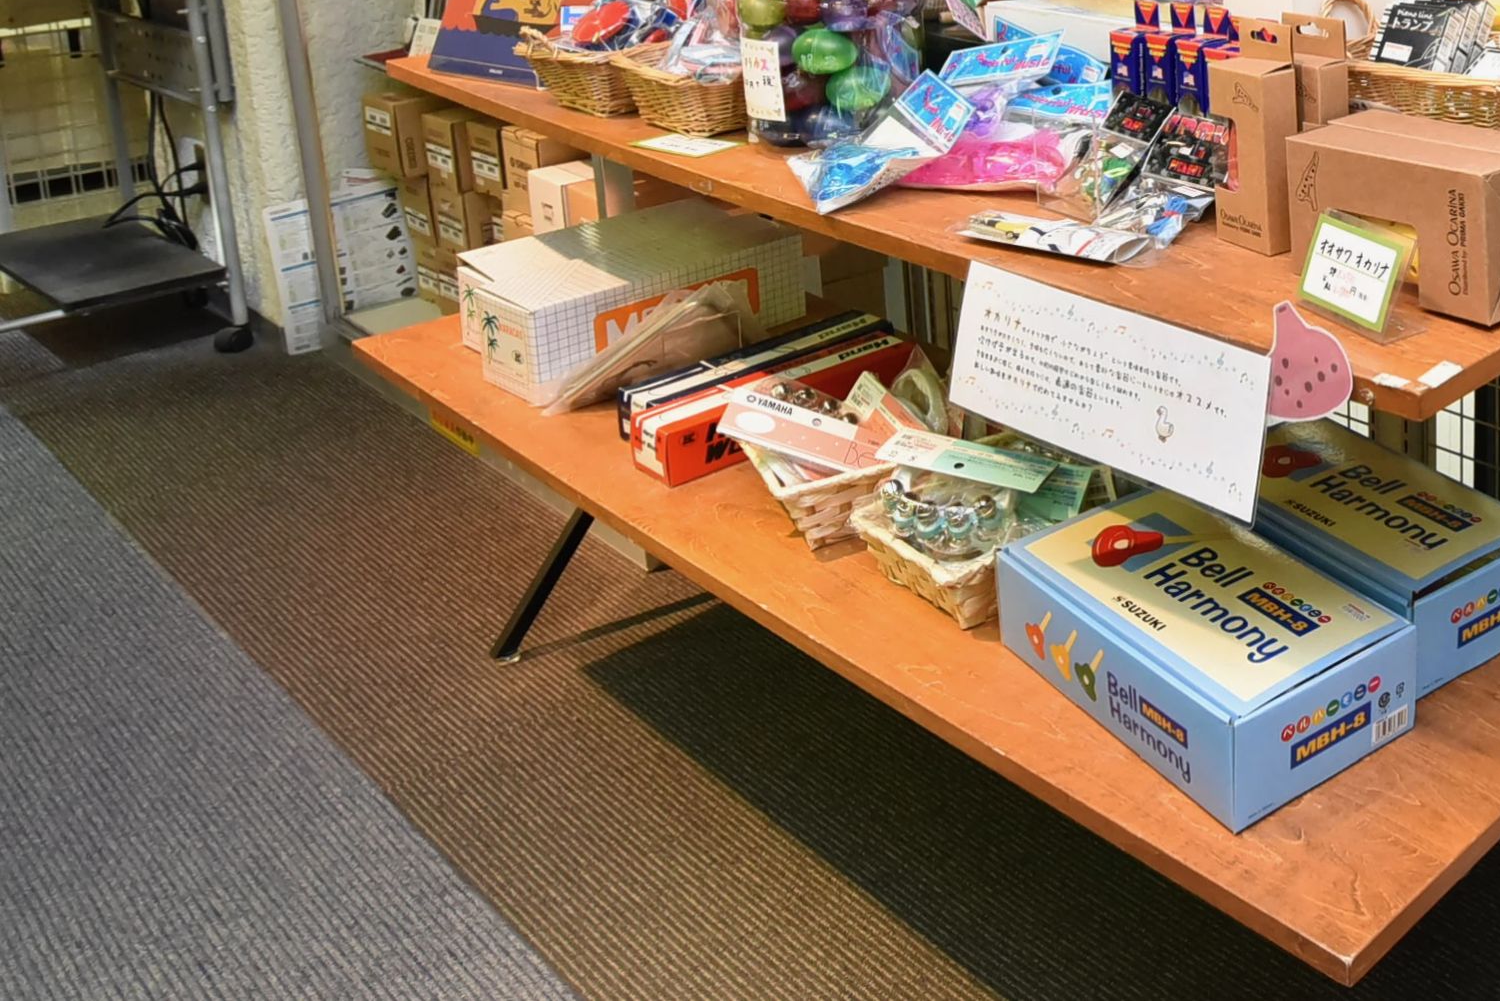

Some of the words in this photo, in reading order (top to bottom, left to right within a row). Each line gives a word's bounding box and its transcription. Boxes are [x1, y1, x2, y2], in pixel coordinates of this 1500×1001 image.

[1391, 16, 1434, 33] トランプ
[1446, 188, 1460, 247] OCARINA
[1320, 238, 1353, 263] オオサワ
[1355, 252, 1390, 280] オカリナ
[1448, 250, 1462, 296] OSAWA
[838, 338, 890, 361] Hand
[756, 397, 794, 417] YAMAHA
[1338, 464, 1406, 495] Bell
[1291, 500, 1336, 528] SUZUKI
[1309, 474, 1449, 550] Harmony
[1406, 497, 1462, 530] MBH-8
[1177, 547, 1254, 588] Bell
[1121, 599, 1168, 632] SUZUKI
[1143, 562, 1289, 664] Harmony
[1245, 589, 1308, 632] MBH-8
[1106, 670, 1139, 714] Bell
[1281, 675, 1382, 742] ベルハーモニー
[1108, 695, 1192, 785] Harmony
[1141, 701, 1186, 744] MBH-8
[1296, 711, 1368, 762] MBH-8
